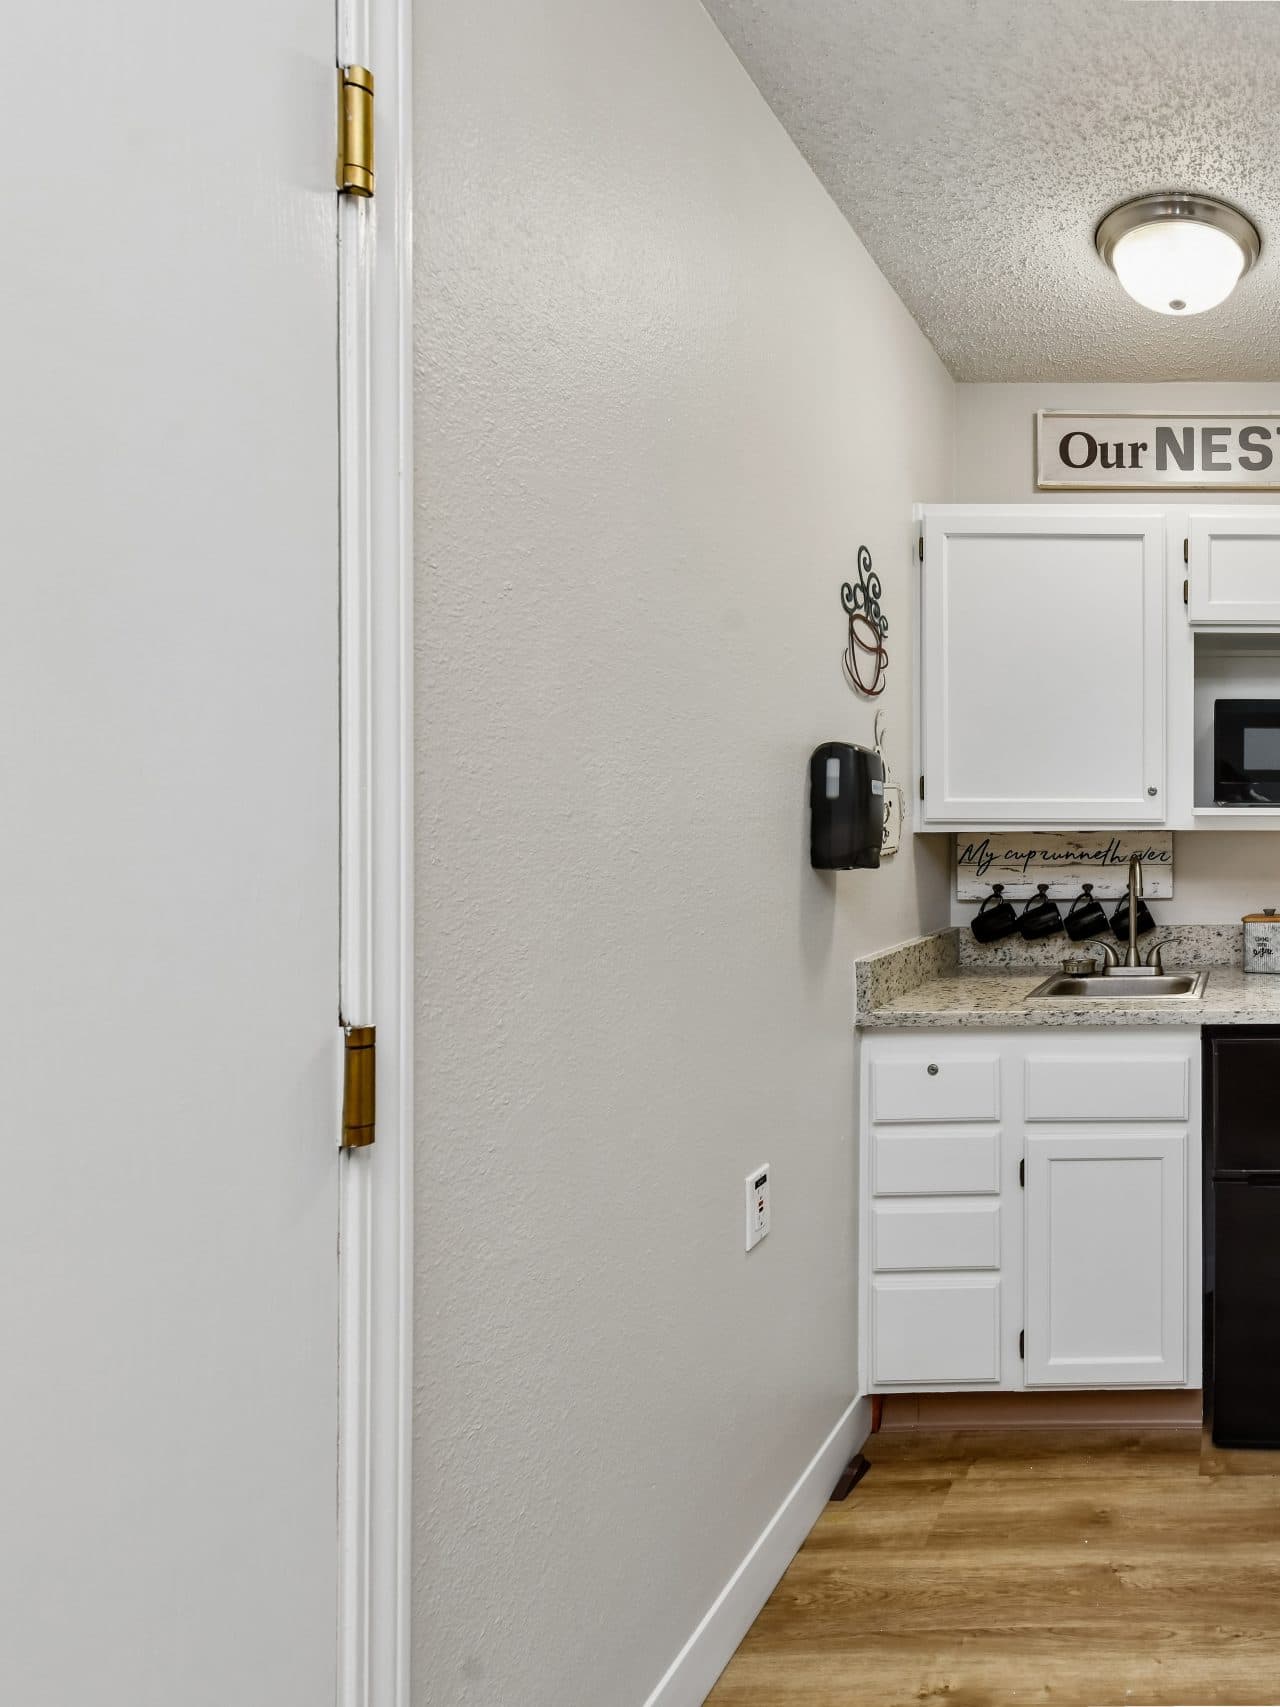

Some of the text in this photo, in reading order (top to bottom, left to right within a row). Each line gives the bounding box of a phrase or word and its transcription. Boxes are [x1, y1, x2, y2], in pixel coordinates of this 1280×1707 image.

[1058, 431, 1148, 469] Our
[958, 838, 1000, 877] My
[1004, 849, 1037, 873] cup
[1039, 837, 1126, 867] runneth
